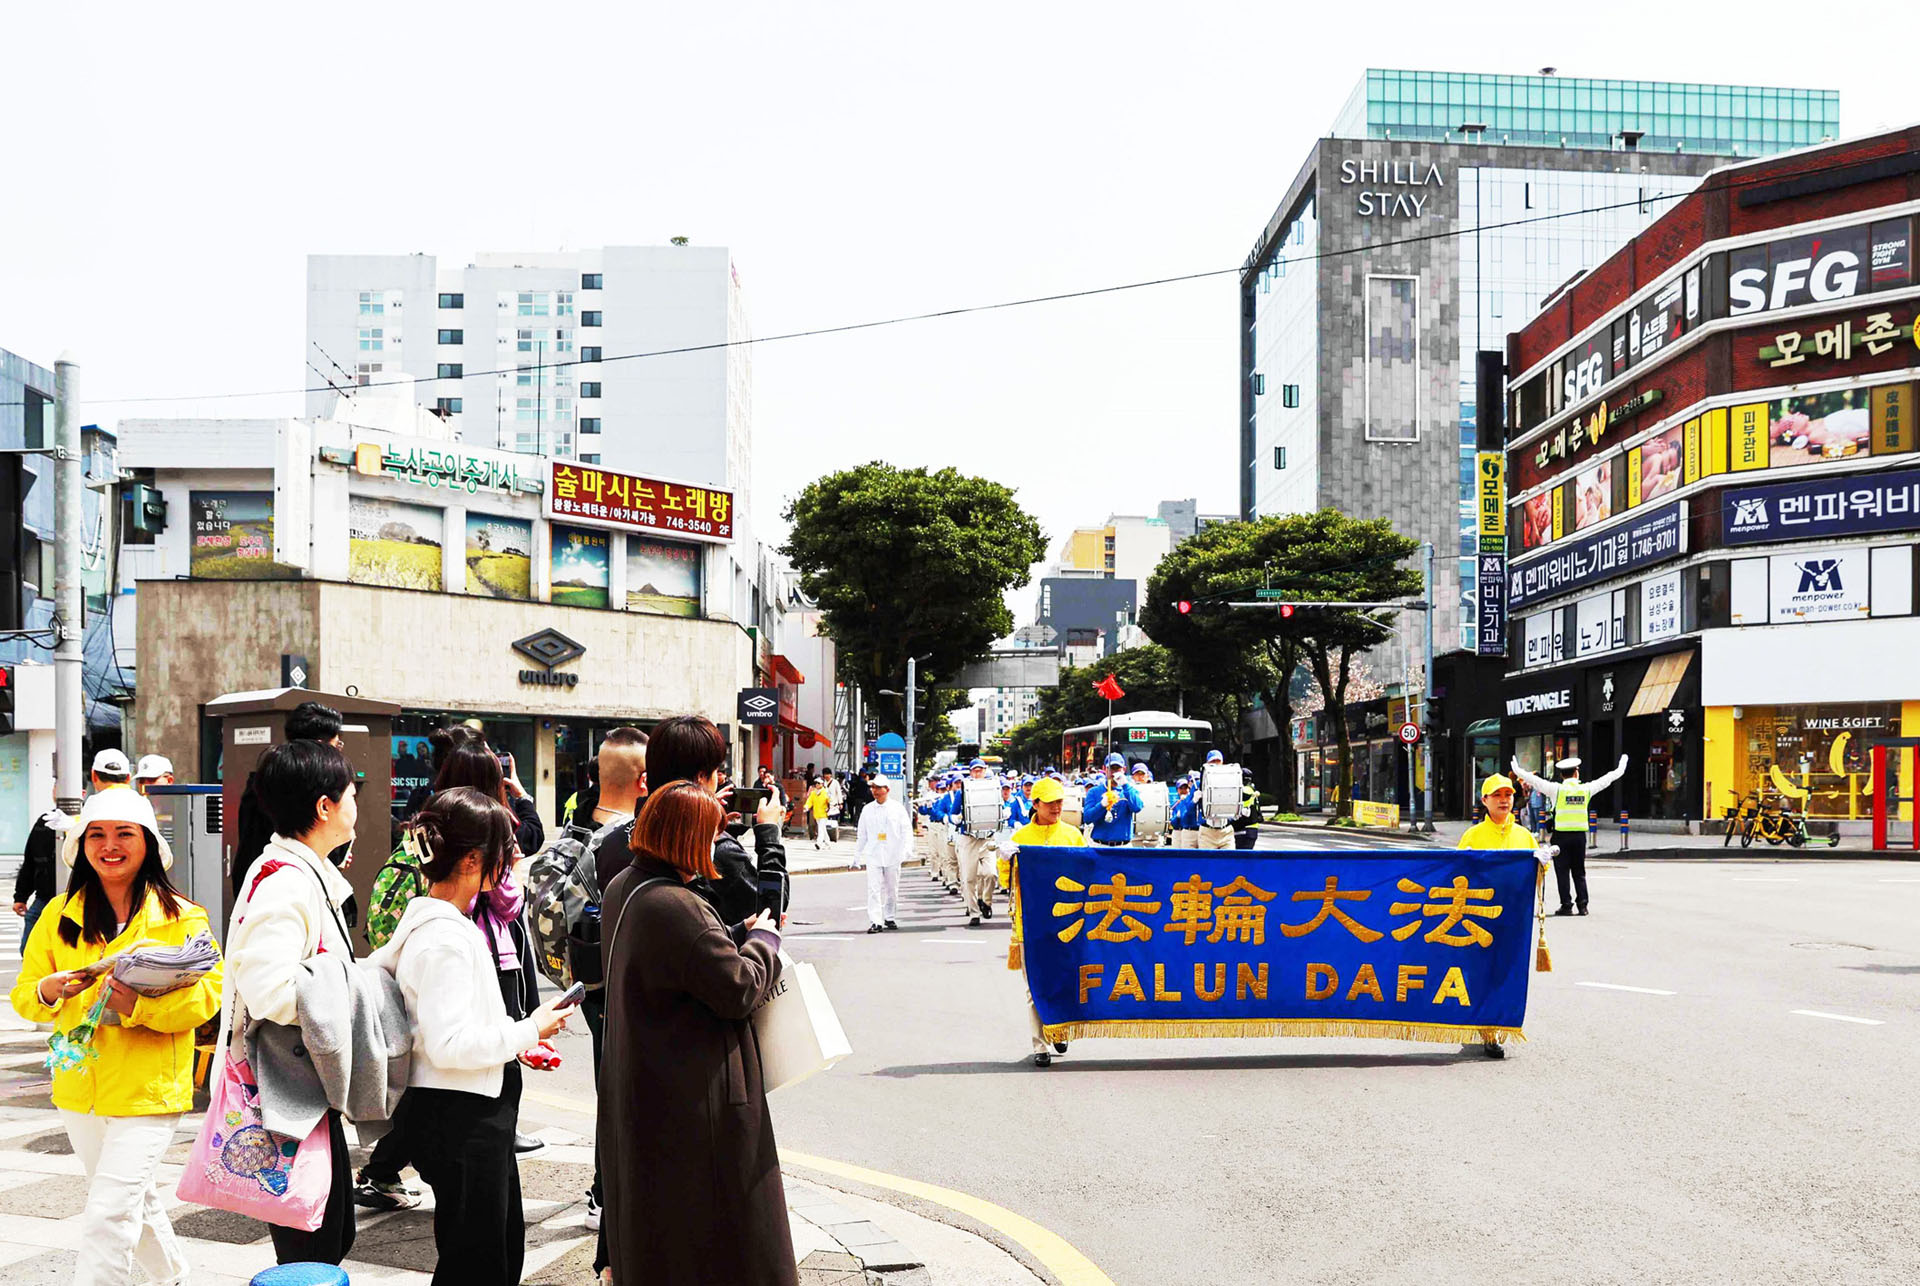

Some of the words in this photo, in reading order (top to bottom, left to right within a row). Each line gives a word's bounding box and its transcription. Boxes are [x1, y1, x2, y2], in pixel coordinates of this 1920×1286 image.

[1340, 159, 1444, 187] SHILLA
[1358, 191, 1428, 218] STAY
[1872, 239, 1906, 252] STRONG
[1729, 250, 1860, 317] SFG
[1769, 311, 1901, 368] 모메존
[1564, 351, 1603, 409] SFG
[1539, 417, 1584, 469] 모메존
[1743, 410, 1756, 463] 피부관리
[384, 443, 519, 494] 녹산공인중개사
[554, 466, 656, 511] 술마시는
[660, 484, 731, 522] 노래방
[1483, 480, 1499, 531] 모메존
[666, 516, 711, 534] 746-3540
[719, 525, 730, 535] 2F
[1483, 585, 1500, 642] 비뇨기과
[1791, 592, 1845, 602] menpower
[518, 667, 579, 687] umbro
[1404, 729, 1415, 738] 50
[1806, 718, 1839, 728] WINE
[405, 777, 419, 787] SET
[420, 777, 429, 787] UP
[1051, 872, 1503, 948] 法輪大法
[1079, 962, 1269, 1004] FALUN
[1305, 964, 1472, 1007] DAFA
